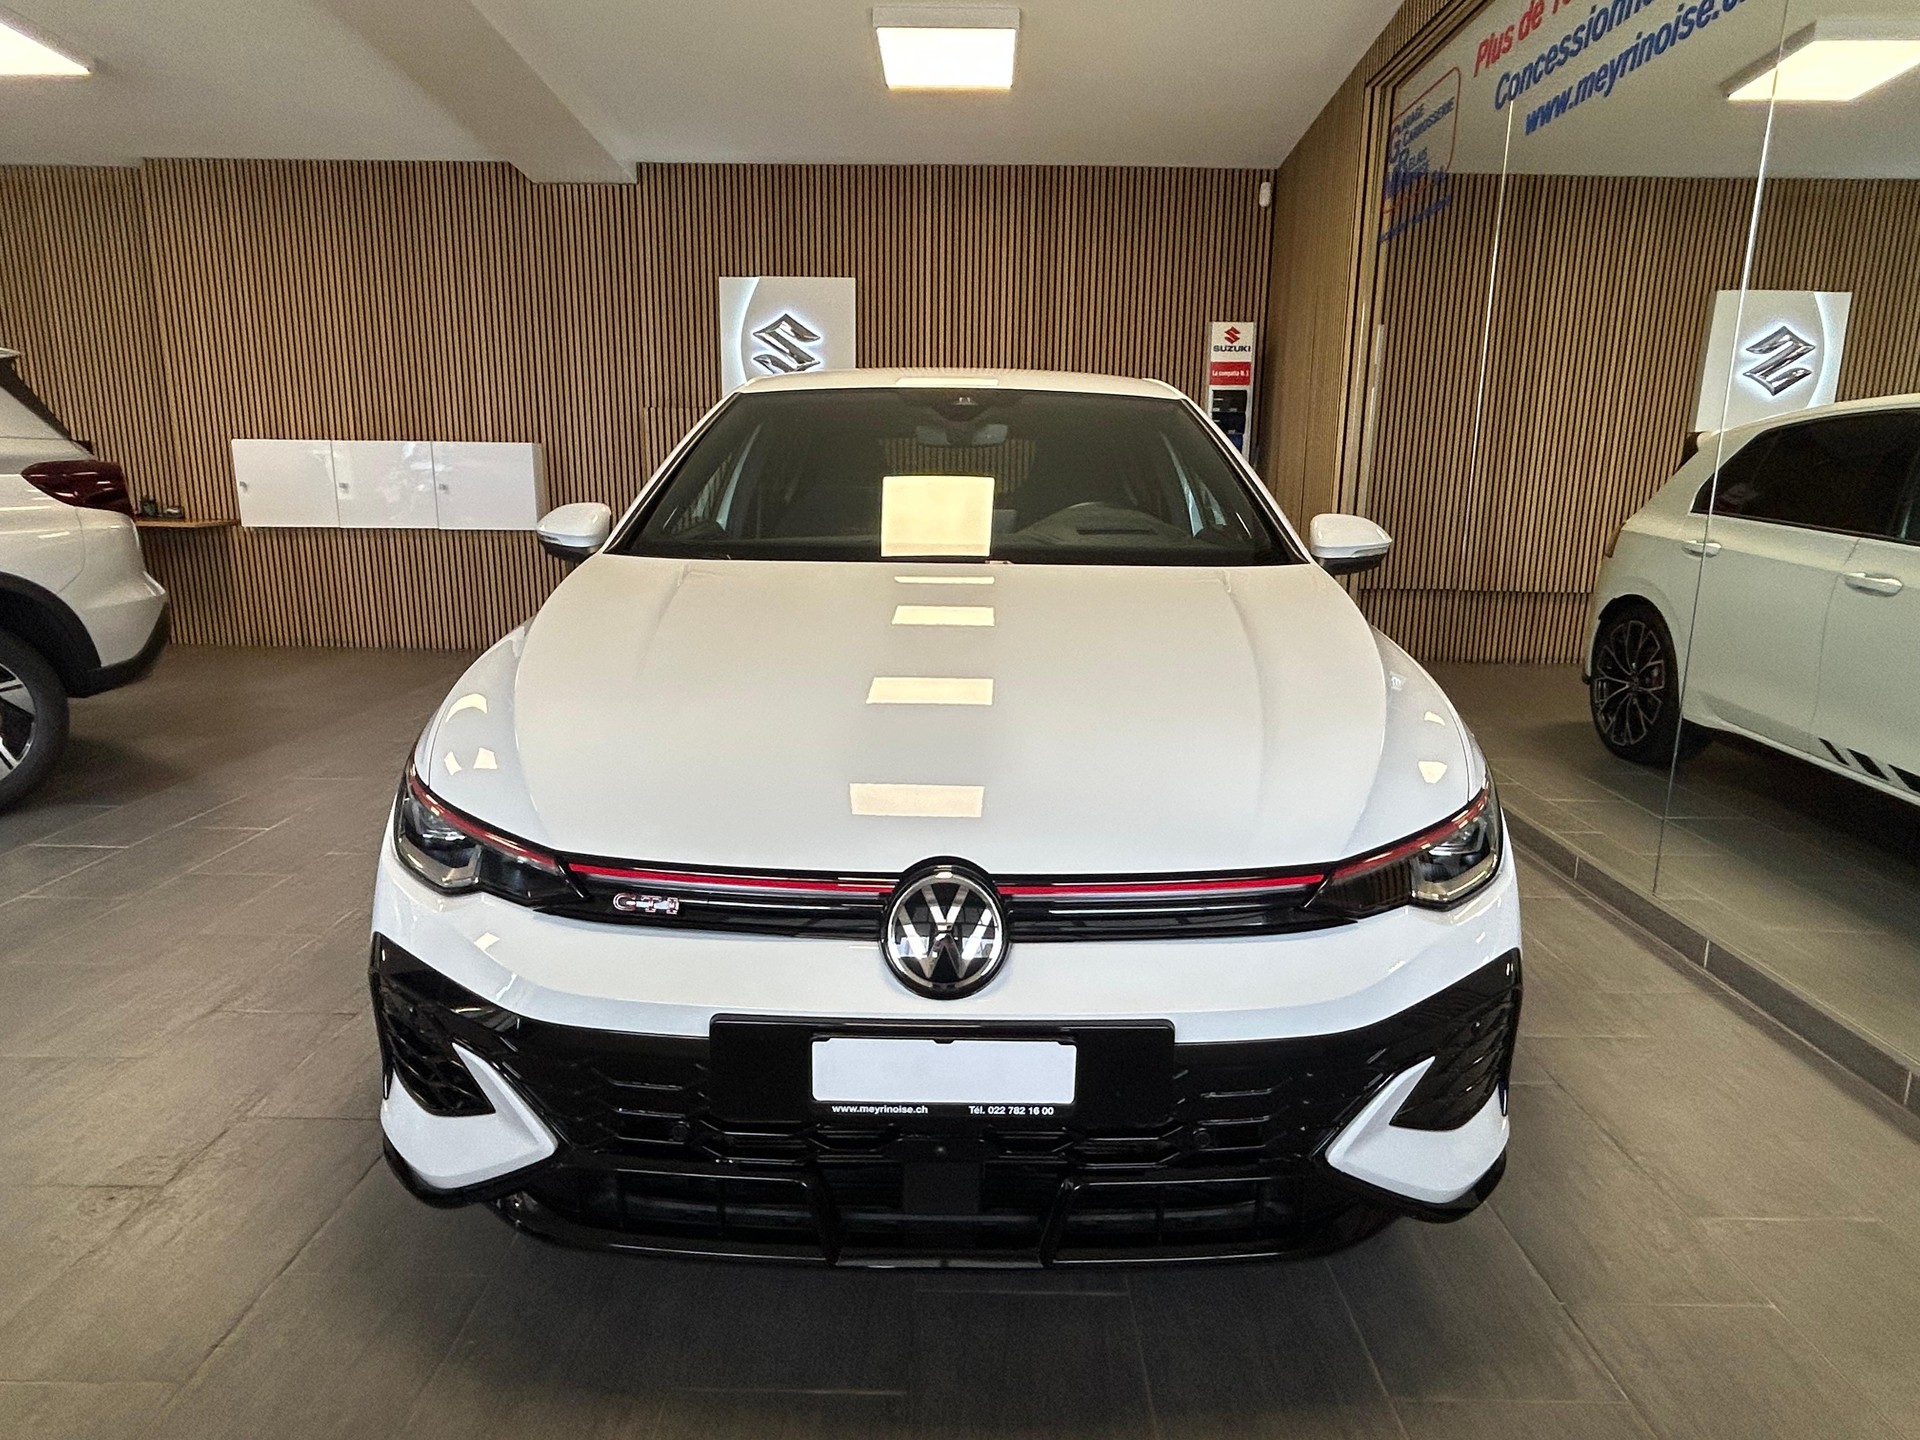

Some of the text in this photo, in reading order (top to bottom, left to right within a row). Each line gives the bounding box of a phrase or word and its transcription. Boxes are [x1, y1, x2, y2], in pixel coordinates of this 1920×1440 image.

[1473, 0, 1545, 78] Plus de
[1494, 0, 1655, 110] Concession
[1525, 0, 1746, 136] www.meyrinoise.
[613, 892, 680, 915] GTI
[831, 1104, 929, 1115] www.meyrinoise.ch
[968, 1105, 1055, 1115] Tél. 022 782 16 00
